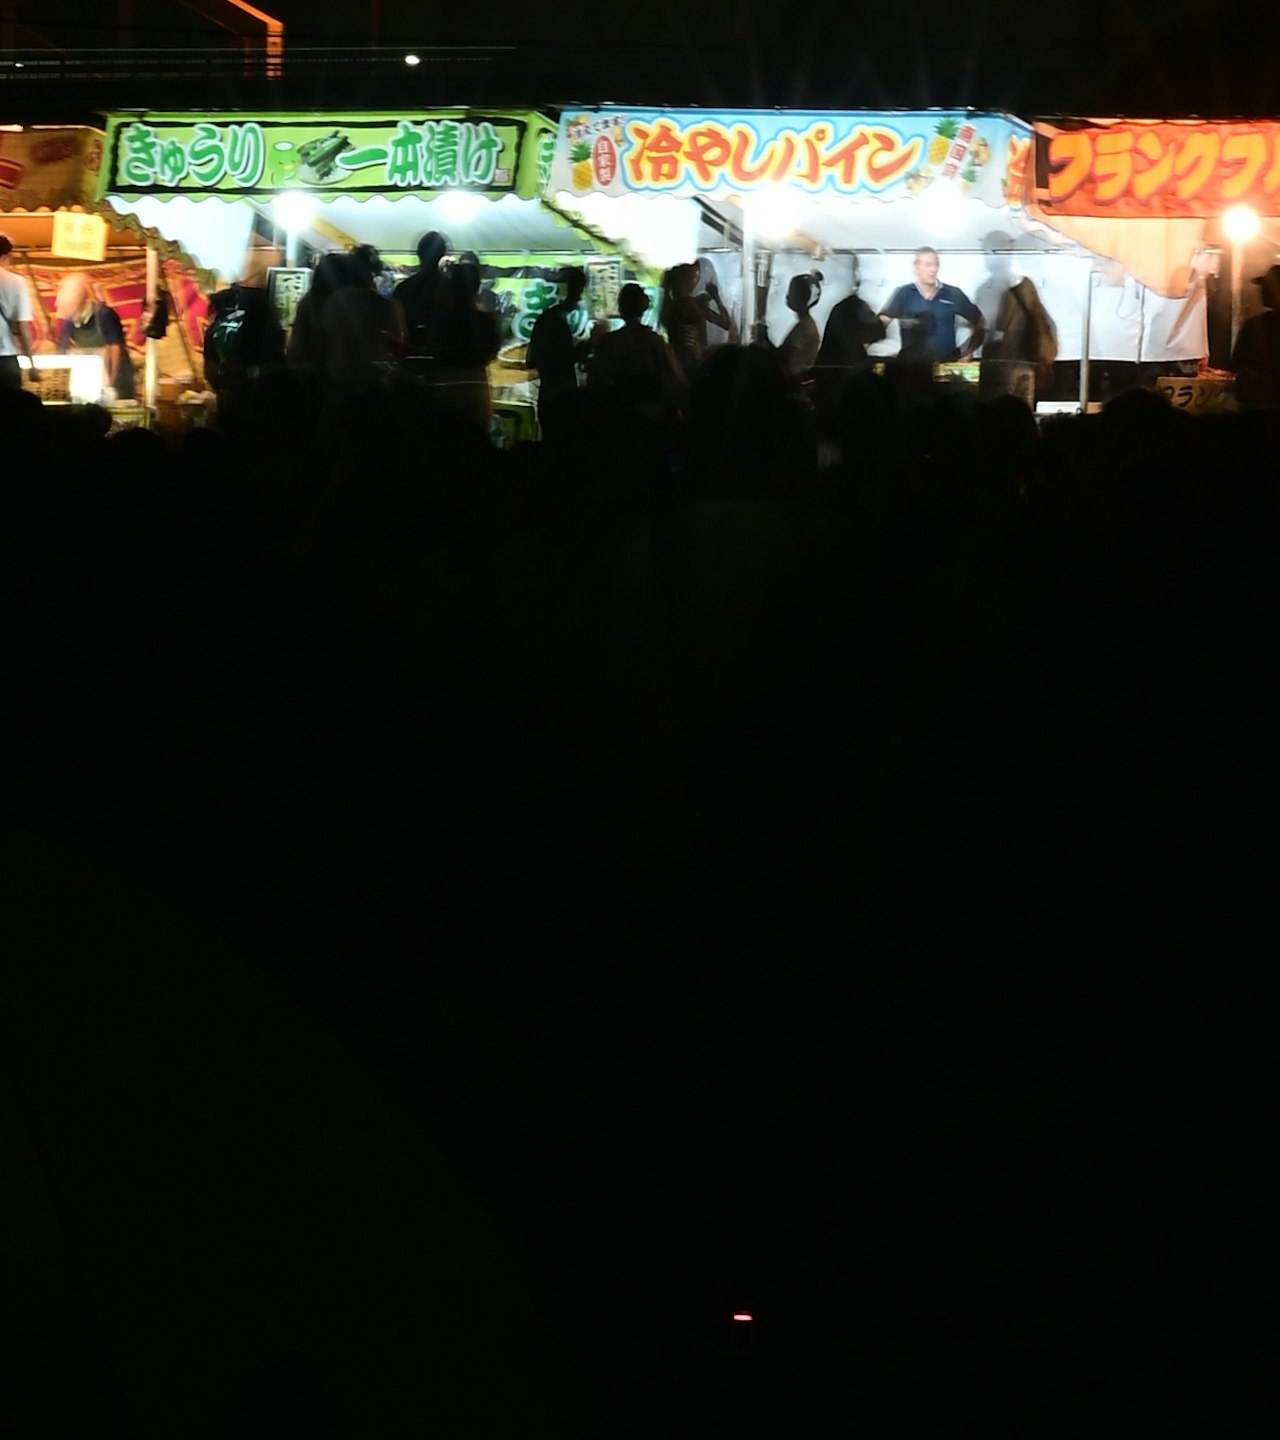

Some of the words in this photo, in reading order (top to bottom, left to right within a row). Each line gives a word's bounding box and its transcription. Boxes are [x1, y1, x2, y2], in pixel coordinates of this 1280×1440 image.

[124, 123, 265, 186] きゅうり
[336, 119, 502, 186] 一本漬け
[627, 122, 920, 184] 冷やしパイン
